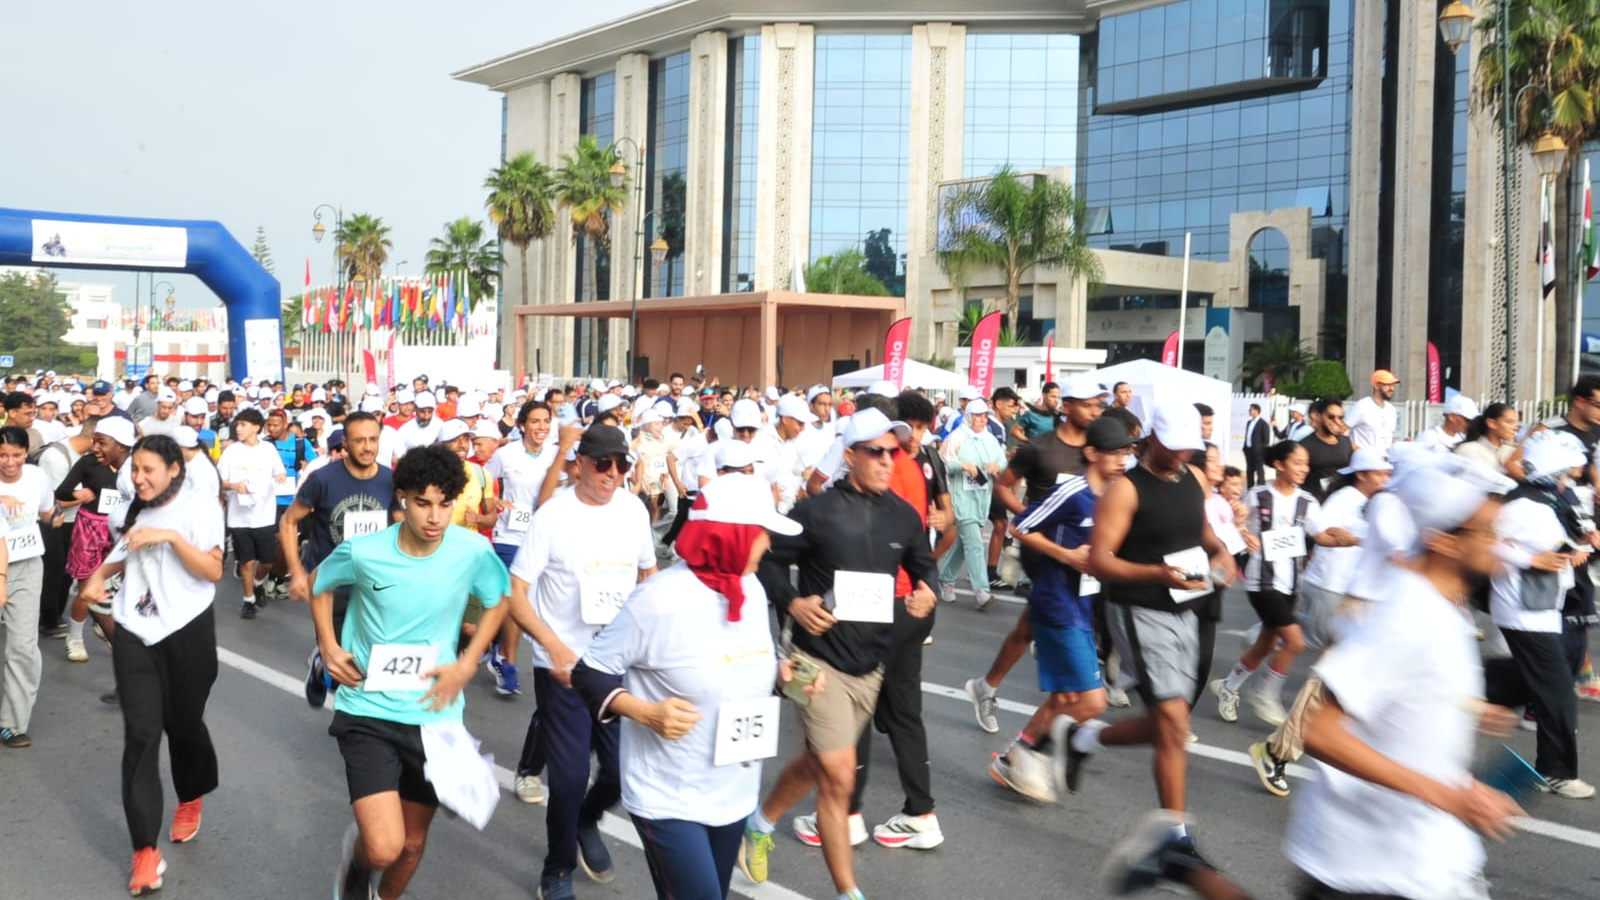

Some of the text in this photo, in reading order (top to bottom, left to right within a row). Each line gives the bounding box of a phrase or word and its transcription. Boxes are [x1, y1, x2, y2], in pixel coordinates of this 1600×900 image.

[889, 340, 903, 385] rabia
[515, 510, 531, 523] 28
[8, 534, 37, 551] 738
[382, 656, 423, 675] 421
[730, 715, 764, 742] 315
